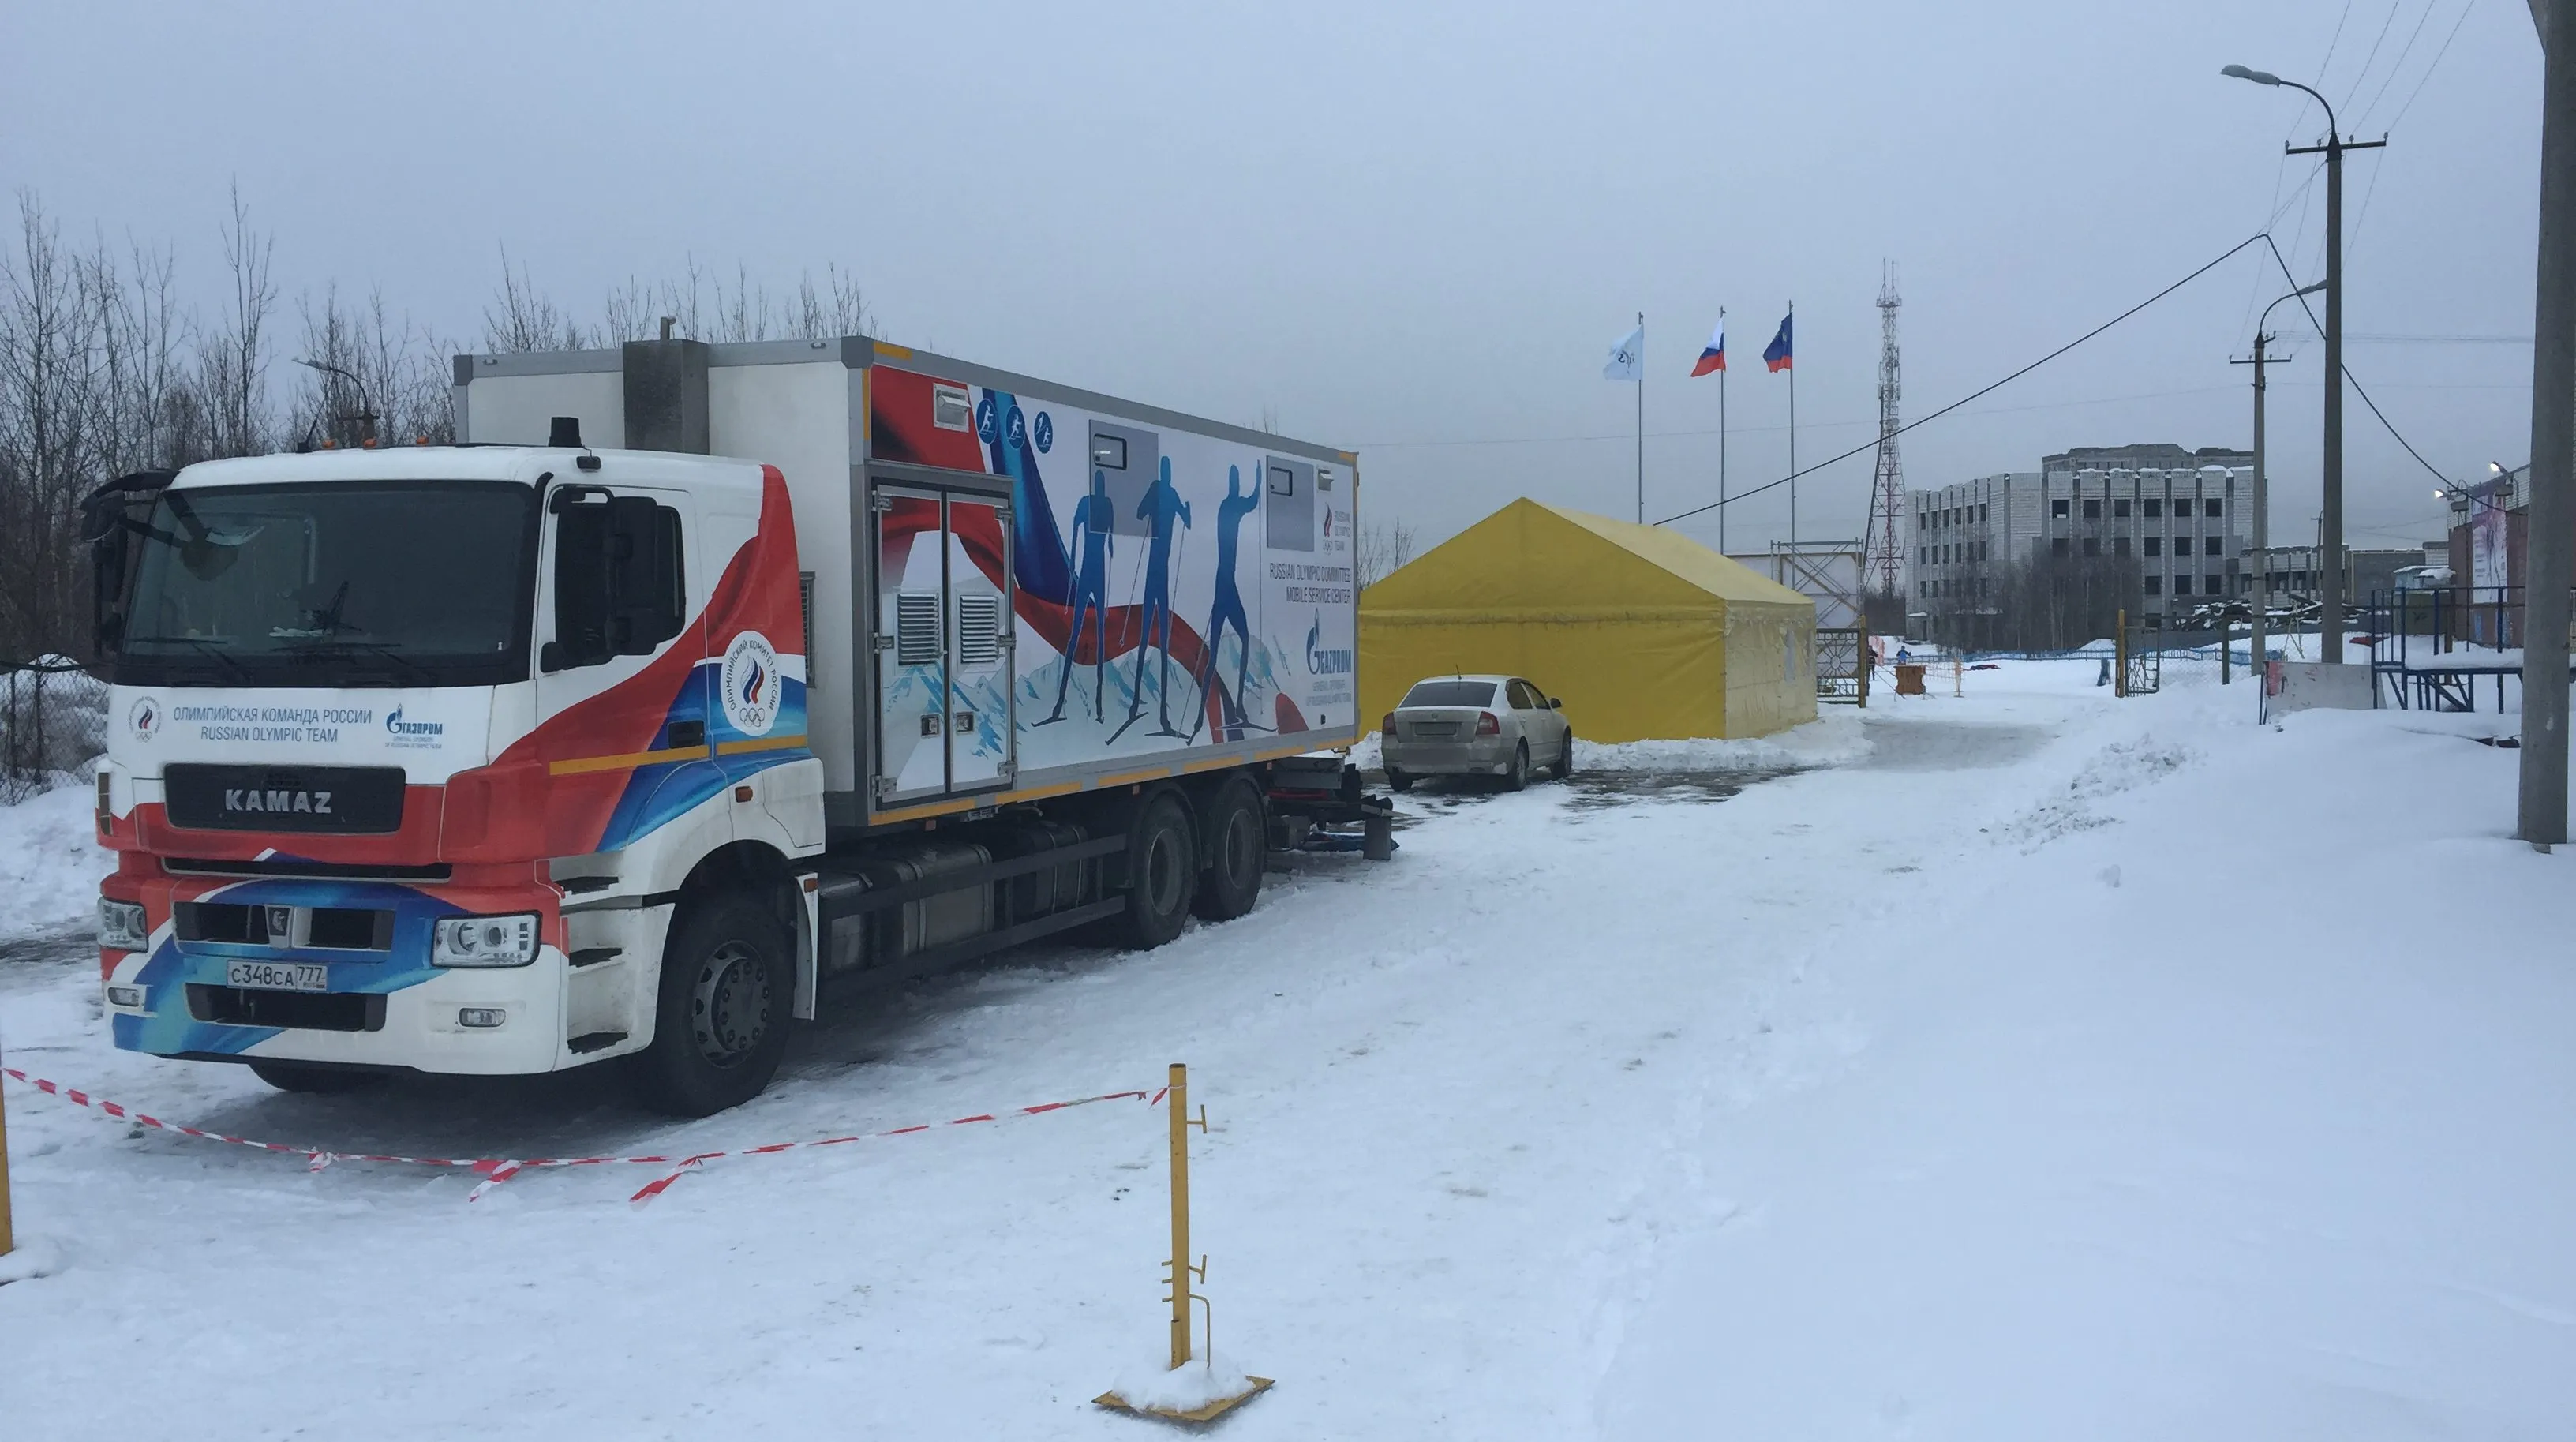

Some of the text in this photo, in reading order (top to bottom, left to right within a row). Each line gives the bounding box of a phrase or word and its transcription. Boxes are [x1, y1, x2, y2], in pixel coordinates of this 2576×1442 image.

[1270, 563, 1295, 580] RUSSIAN
[749, 640, 773, 668] КОМИТЕТ
[768, 669, 777, 710] РОССИИ
[173, 706, 258, 721] ОЛИМПИЙСКАЯ
[261, 708, 319, 725] КОМАНДА
[323, 709, 373, 724] РОССИИ
[200, 726, 339, 743] RUSSIAN OLYMPIC TEAM
[402, 722, 443, 735] ГАЗПРОМ
[225, 789, 331, 814] KAMAZ
